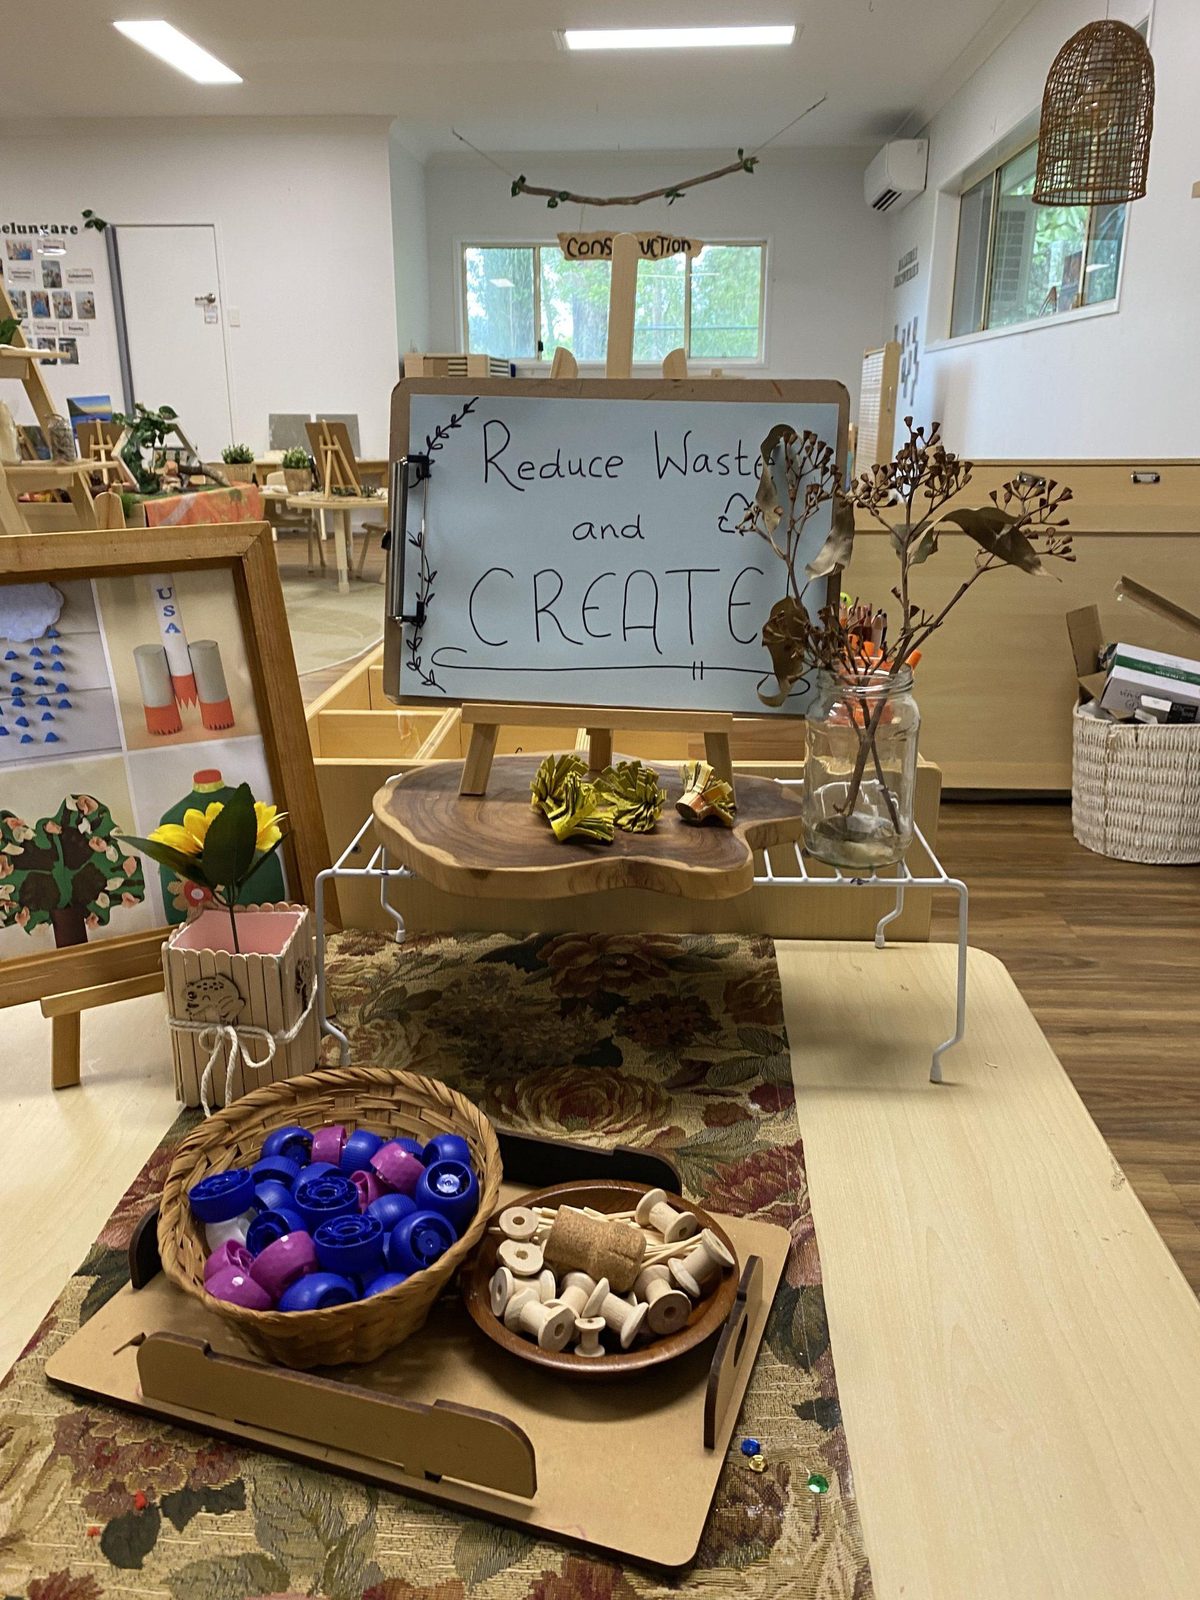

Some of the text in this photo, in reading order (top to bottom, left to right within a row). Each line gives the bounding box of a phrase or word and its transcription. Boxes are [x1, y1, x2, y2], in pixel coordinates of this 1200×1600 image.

[0, 222, 79, 237] elungare
[483, 419, 776, 492] Reduce Waste
[571, 514, 646, 541] and
[156, 586, 182, 634] USA
[468, 566, 764, 655] CREATE
